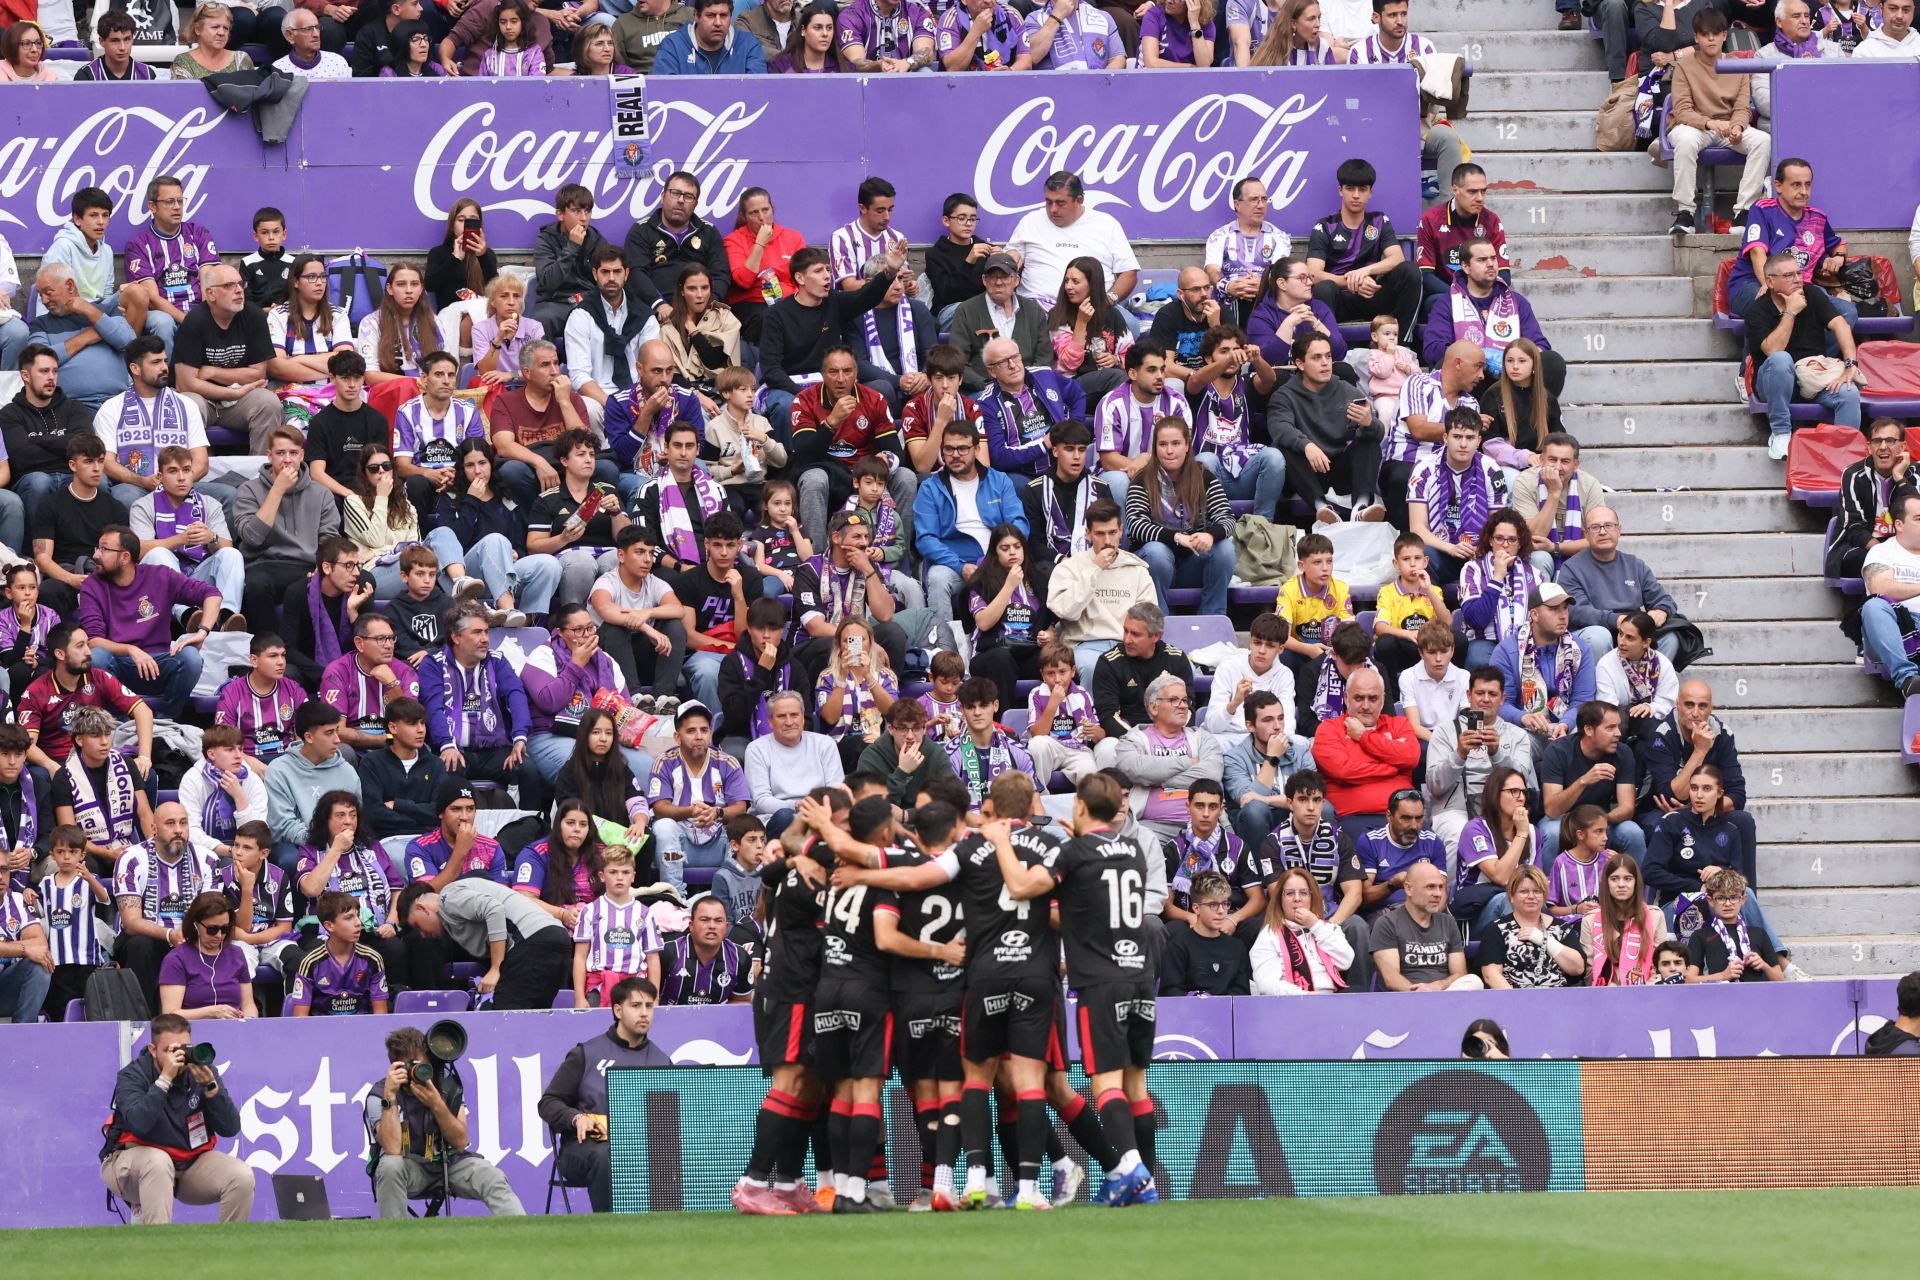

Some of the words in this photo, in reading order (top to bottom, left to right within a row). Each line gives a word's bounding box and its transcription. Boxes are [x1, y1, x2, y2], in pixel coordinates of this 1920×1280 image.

[1461, 44, 1483, 61] 13
[617, 86, 645, 138] REAL
[1495, 123, 1518, 140] 12
[413, 100, 769, 222] Coca-Cola
[973, 94, 1328, 216] Coca-Cola
[1527, 207, 1546, 223] 11
[1583, 333, 1605, 350] 10
[1623, 417, 1636, 435] 9
[118, 429, 151, 443] 1928
[154, 433, 187, 445] 1928
[1661, 504, 1674, 522] 8
[1094, 589, 1131, 597] STUDIOS
[1695, 592, 1708, 609] 7
[1007, 607, 1031, 616] Estrella
[1007, 614, 1030, 623] Galicia
[1735, 678, 1748, 696] 6
[1770, 768, 1783, 786] 5
[1811, 857, 1823, 875] 4
[1100, 868, 1143, 929] 16
[1405, 943, 1447, 954] FAMILY
[1851, 944, 1864, 962] 3
[1404, 952, 1447, 966] CLUB
[331, 998, 357, 1006] Estrella
[331, 1004, 356, 1012] Galicia
[1407, 1111, 1518, 1168] EA
[1404, 1174, 1522, 1195] SPORTS
